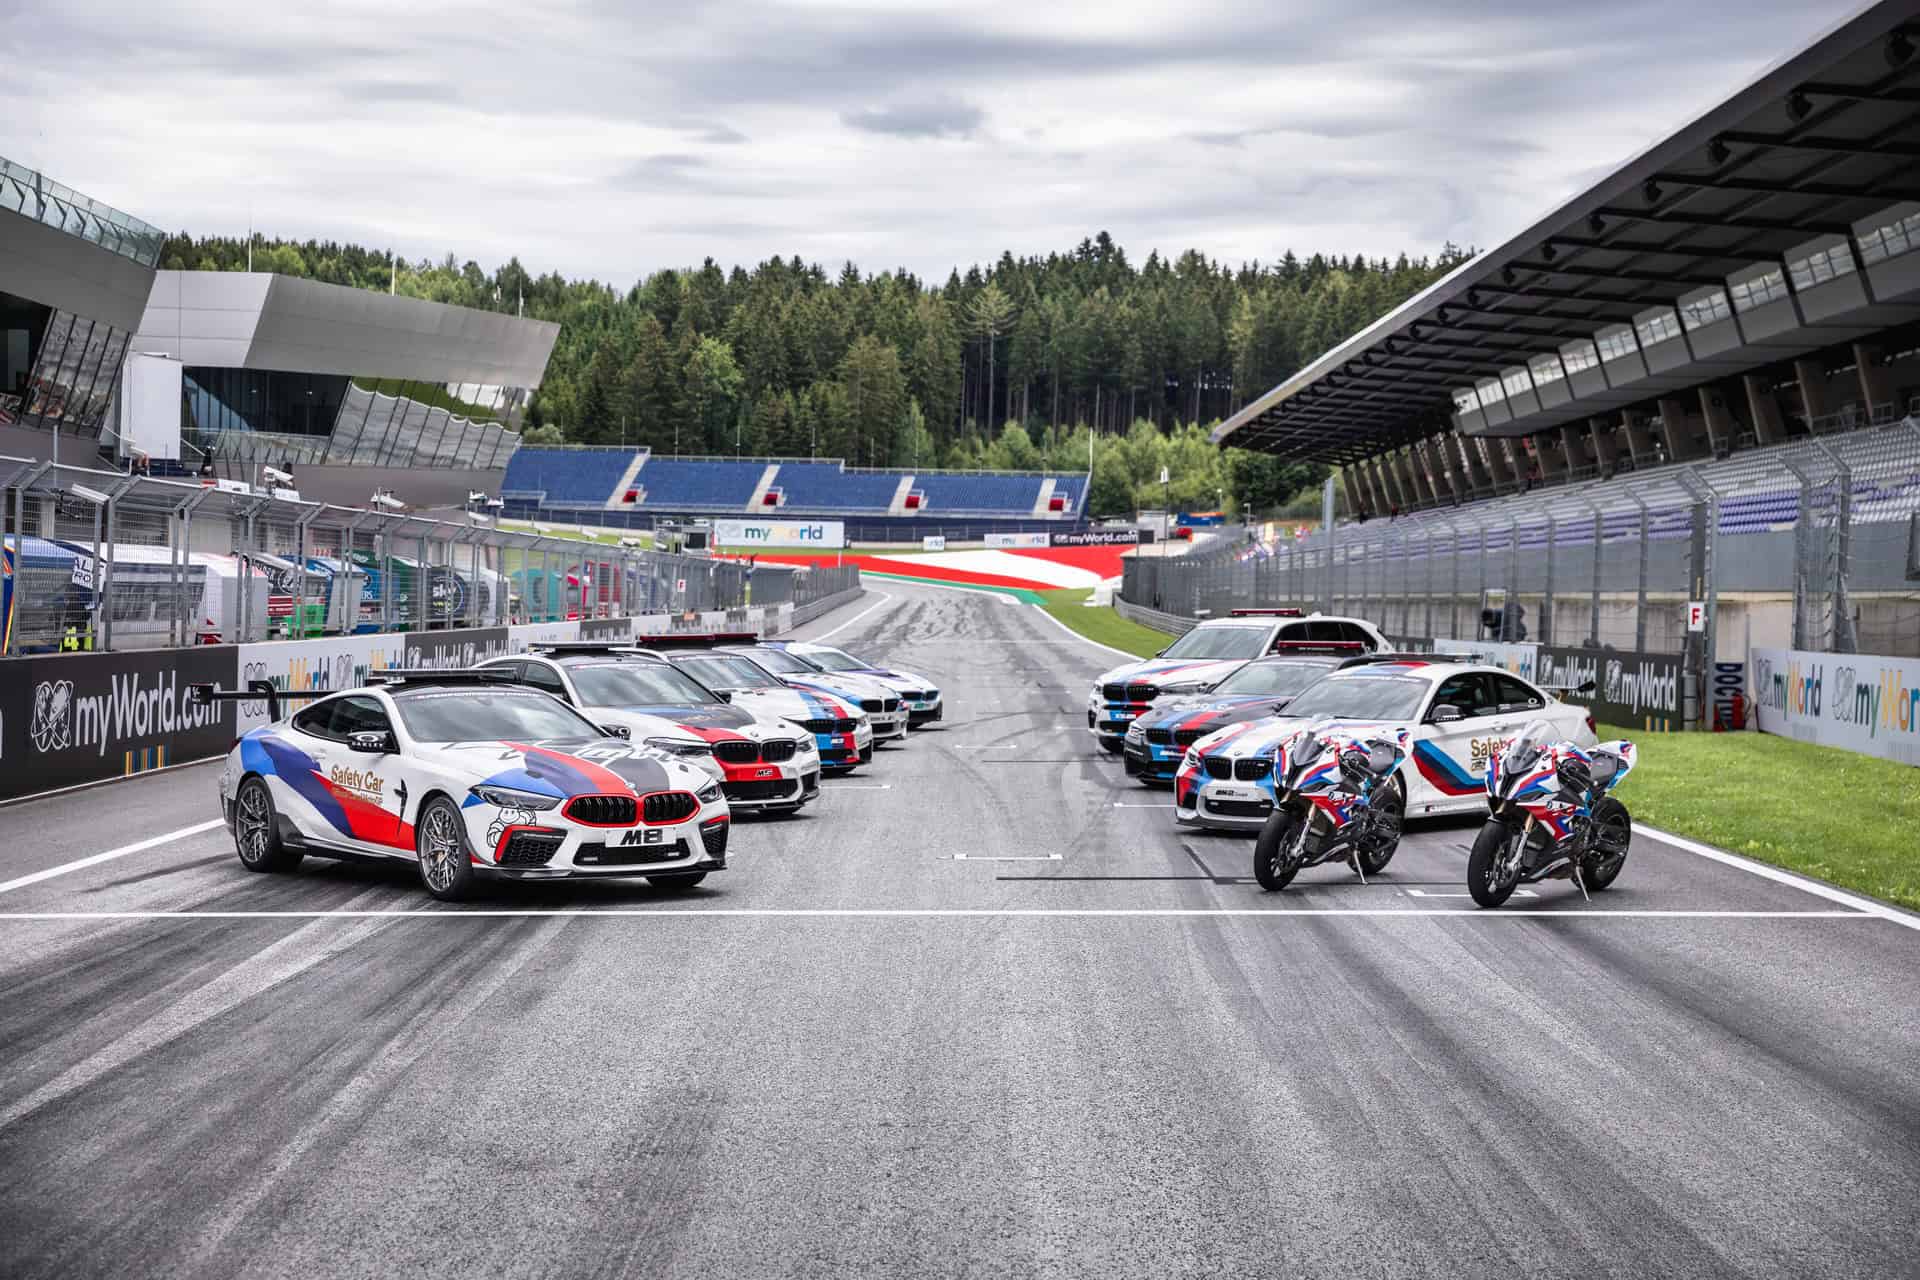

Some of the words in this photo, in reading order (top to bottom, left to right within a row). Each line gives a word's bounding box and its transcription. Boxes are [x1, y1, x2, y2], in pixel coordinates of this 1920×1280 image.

[744, 524, 823, 542] myorld
[1001, 535, 1046, 545] myrld
[1069, 532, 1138, 545] myWorld.com
[1691, 607, 1701, 625] F
[1621, 661, 1677, 715] myWorld
[1773, 661, 1823, 721] myWorld
[75, 670, 222, 756] myWorld.com
[1854, 668, 1920, 739] myWor
[1471, 737, 1508, 757] Safet
[331, 764, 363, 791] Safety
[365, 771, 384, 792] Car
[621, 830, 662, 846] M8
